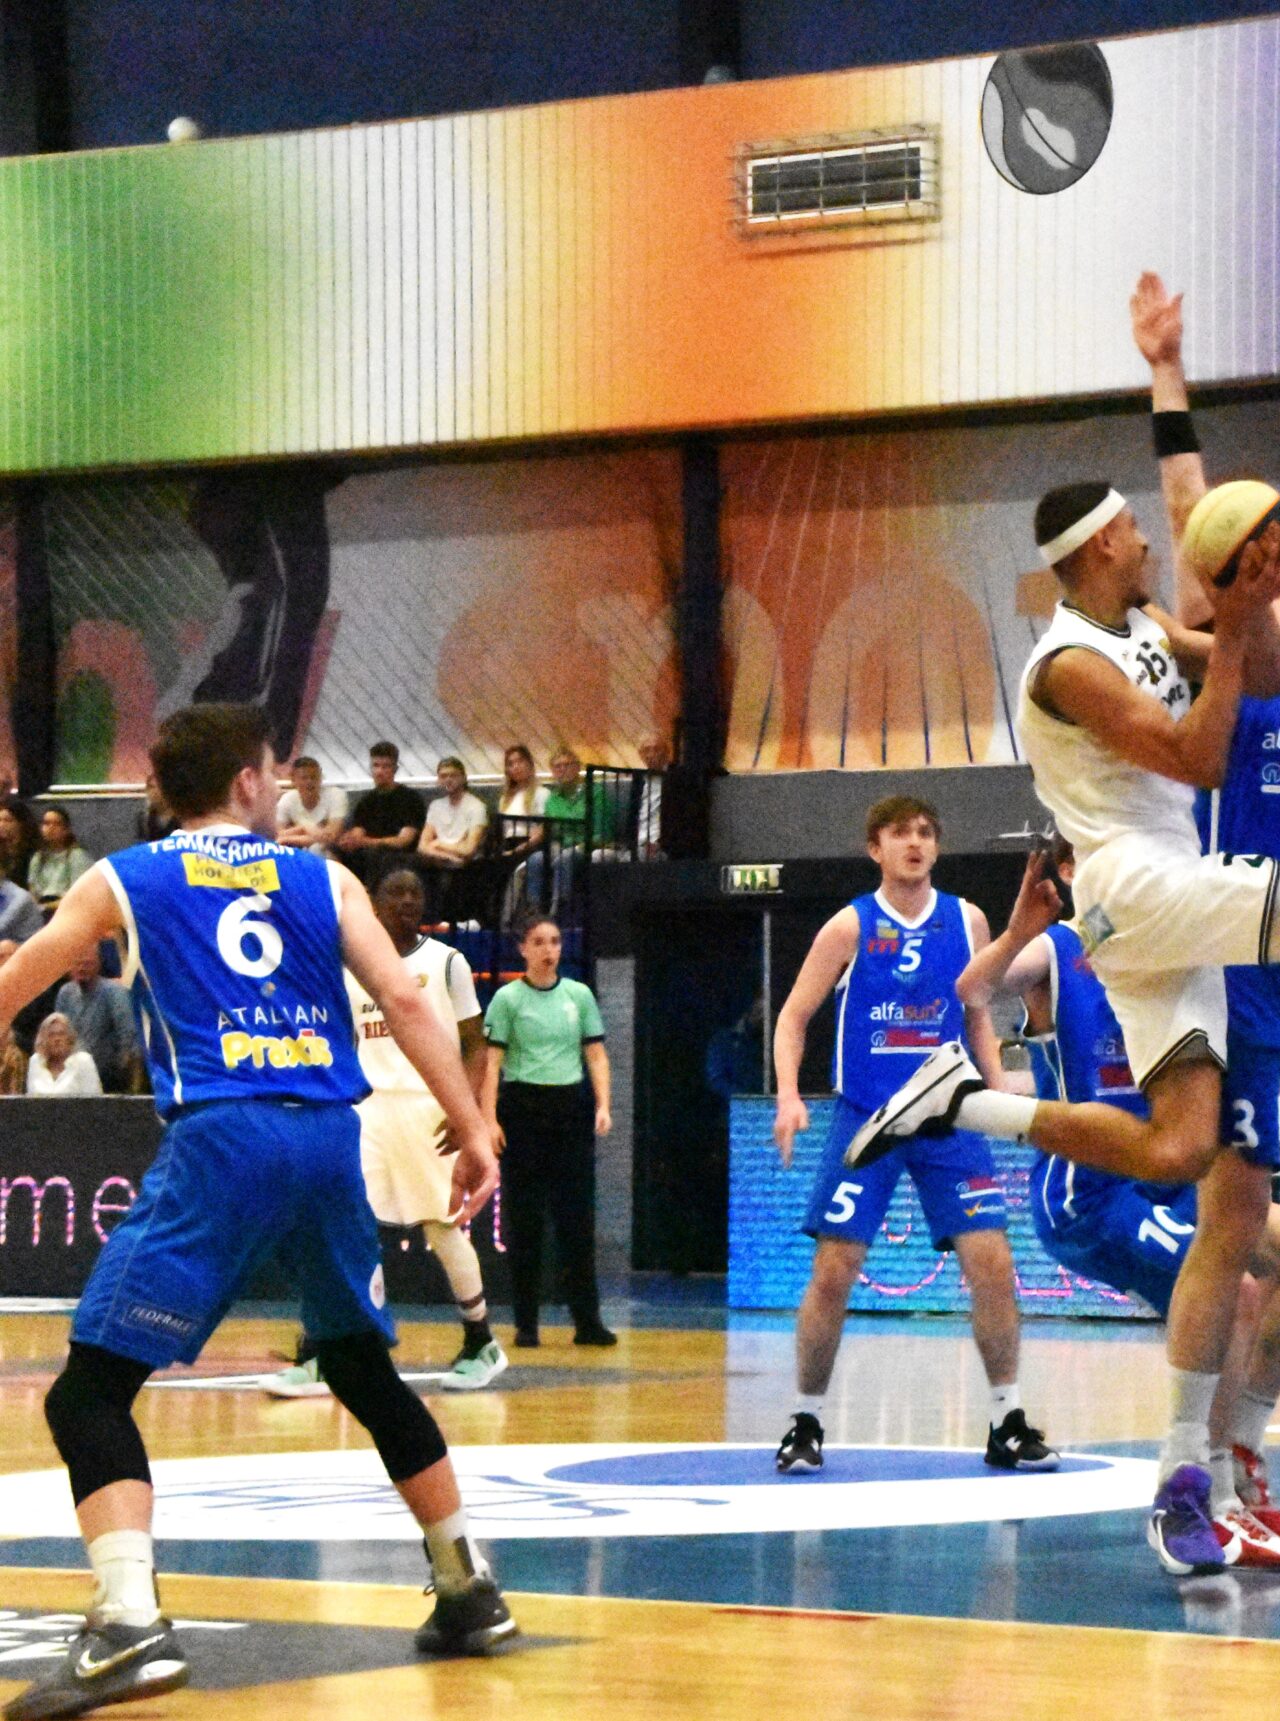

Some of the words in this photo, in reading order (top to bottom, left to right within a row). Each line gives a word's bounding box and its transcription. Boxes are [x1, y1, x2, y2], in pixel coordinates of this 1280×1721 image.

[148, 834, 295, 864] TEMMERMAN
[216, 893, 284, 978] 6
[898, 938, 923, 973] 5
[217, 1004, 329, 1032] ATALIAN
[219, 1029, 334, 1071] Praxis
[824, 1182, 864, 1224] 5
